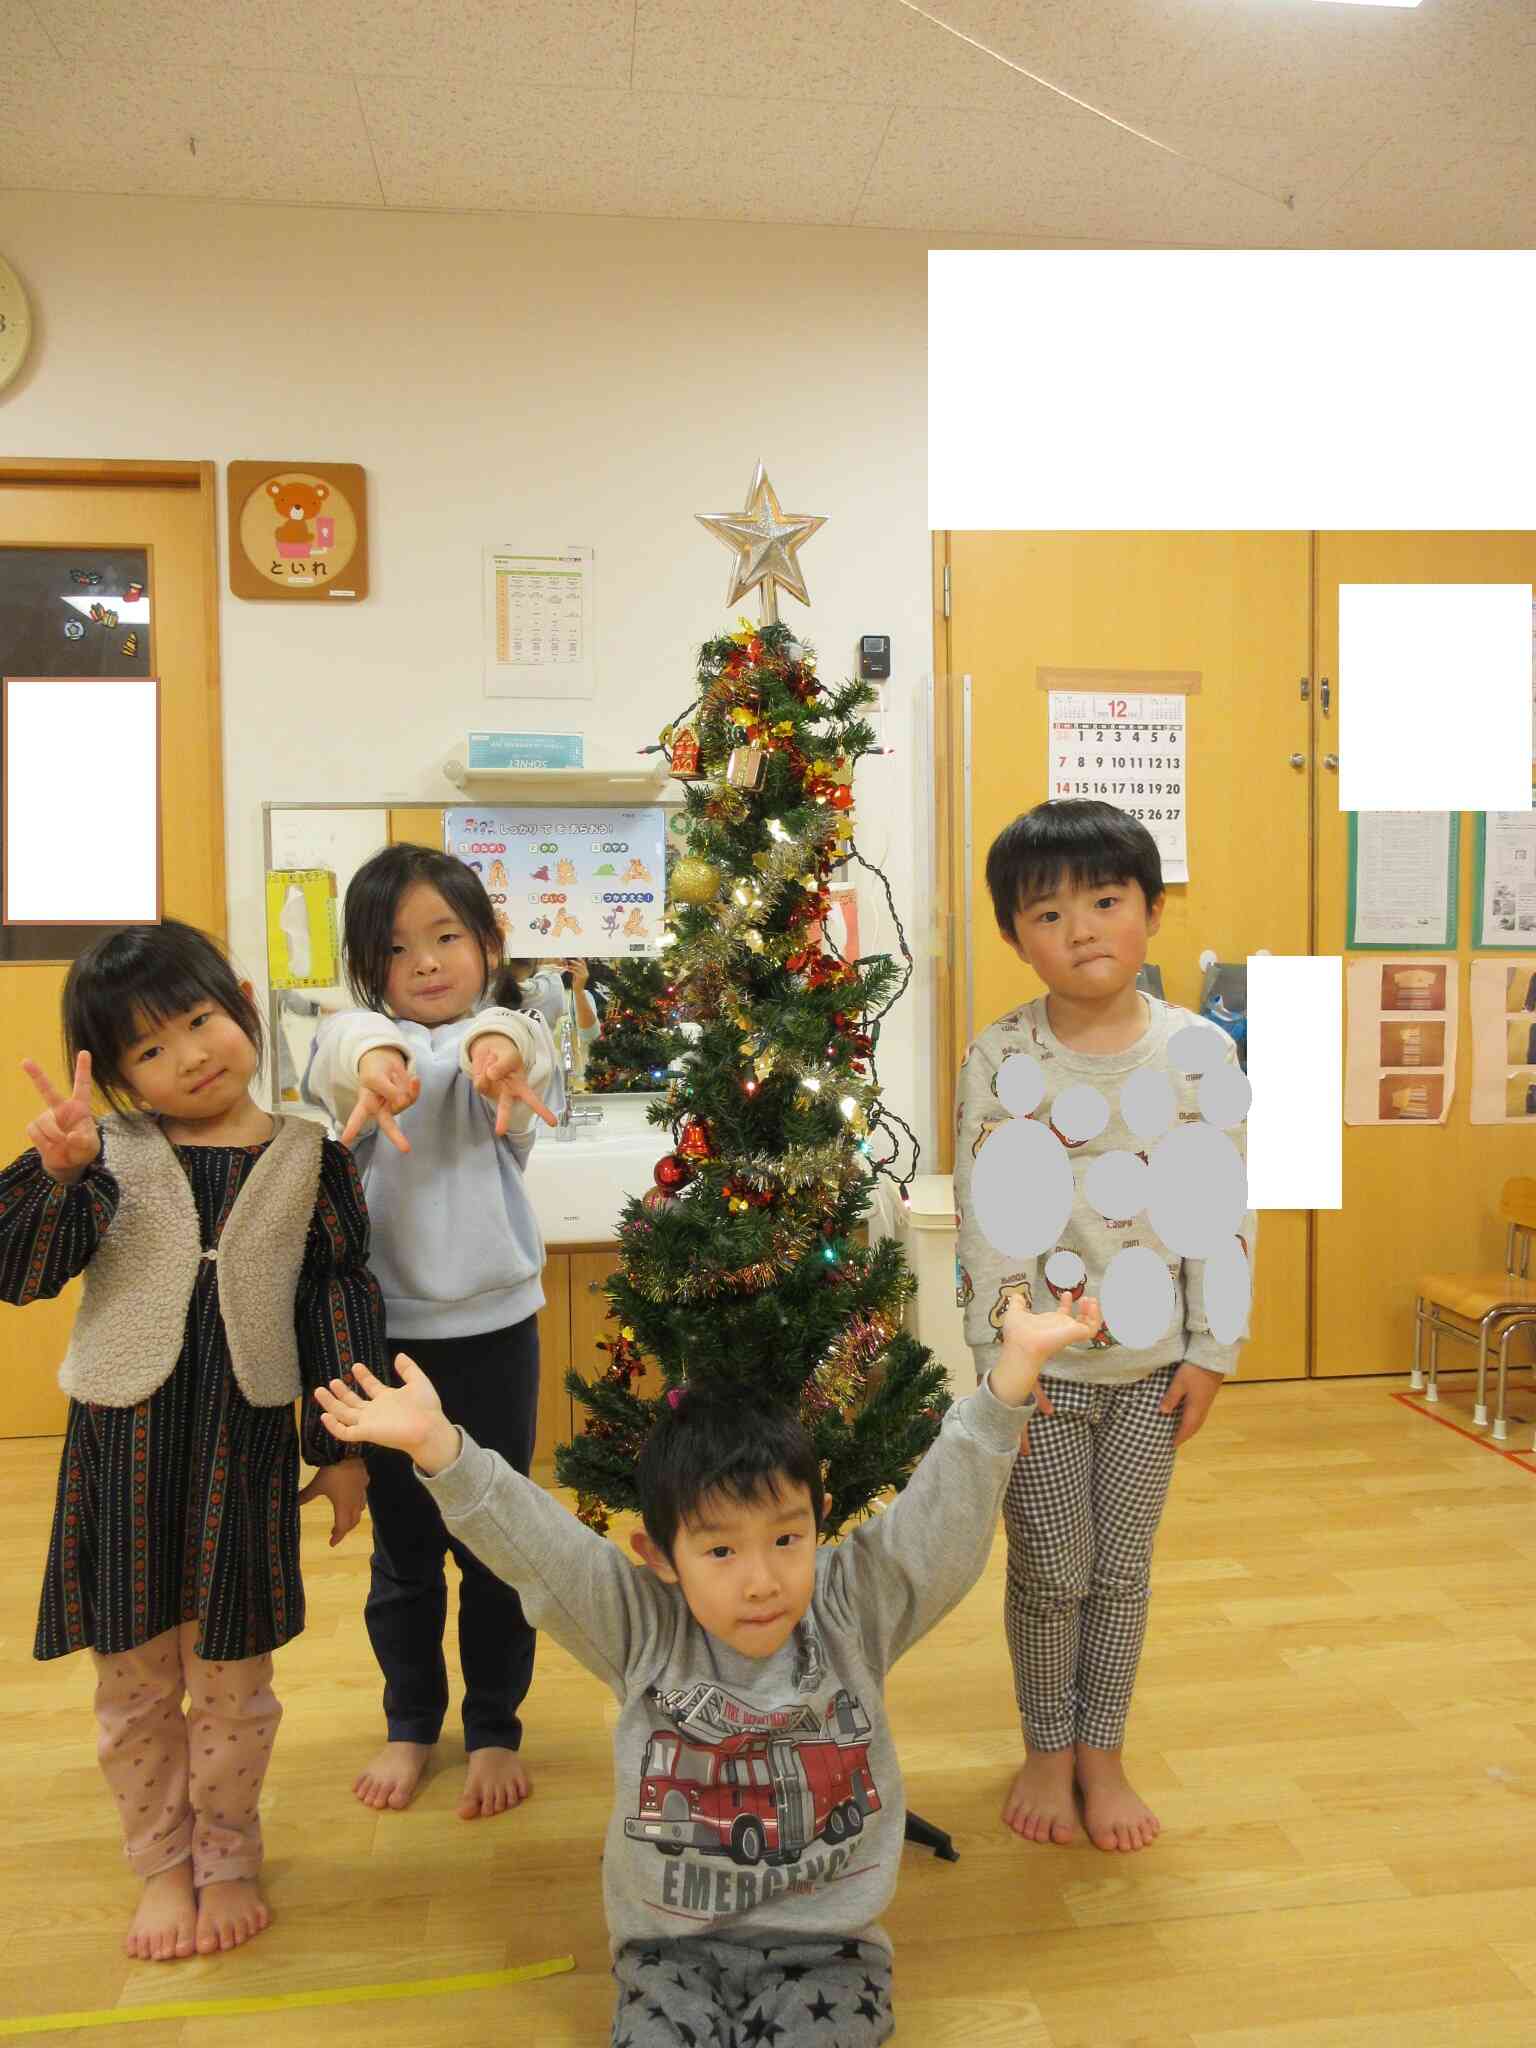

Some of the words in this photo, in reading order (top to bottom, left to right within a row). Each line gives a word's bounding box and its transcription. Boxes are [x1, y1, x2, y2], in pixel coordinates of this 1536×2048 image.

[271, 561, 327, 576] といれ
[1107, 700, 1128, 718] 12
[1078, 731, 1083, 742] 1
[1096, 731, 1103, 742] 2
[1115, 732, 1121, 742] 3
[1132, 732, 1139, 742] 4
[1152, 732, 1158, 743] 5
[1169, 732, 1176, 743] 6
[1060, 757, 1066, 767] 7
[1078, 757, 1084, 767] 8
[1097, 757, 1103, 767] 9
[1112, 758, 1125, 768] 10
[1130, 758, 1142, 768] 11
[1149, 758, 1161, 768] 12
[1167, 758, 1179, 768] 13
[1057, 783, 1070, 793] 14
[1076, 783, 1088, 793] 15
[1095, 783, 1107, 793] 16
[1112, 783, 1125, 793] 17
[1131, 784, 1143, 793] 18
[1149, 784, 1161, 794] 19
[1167, 784, 1180, 794] 20
[1130, 809, 1144, 820] 25
[1148, 809, 1162, 819] 26
[1167, 810, 1180, 819] 27
